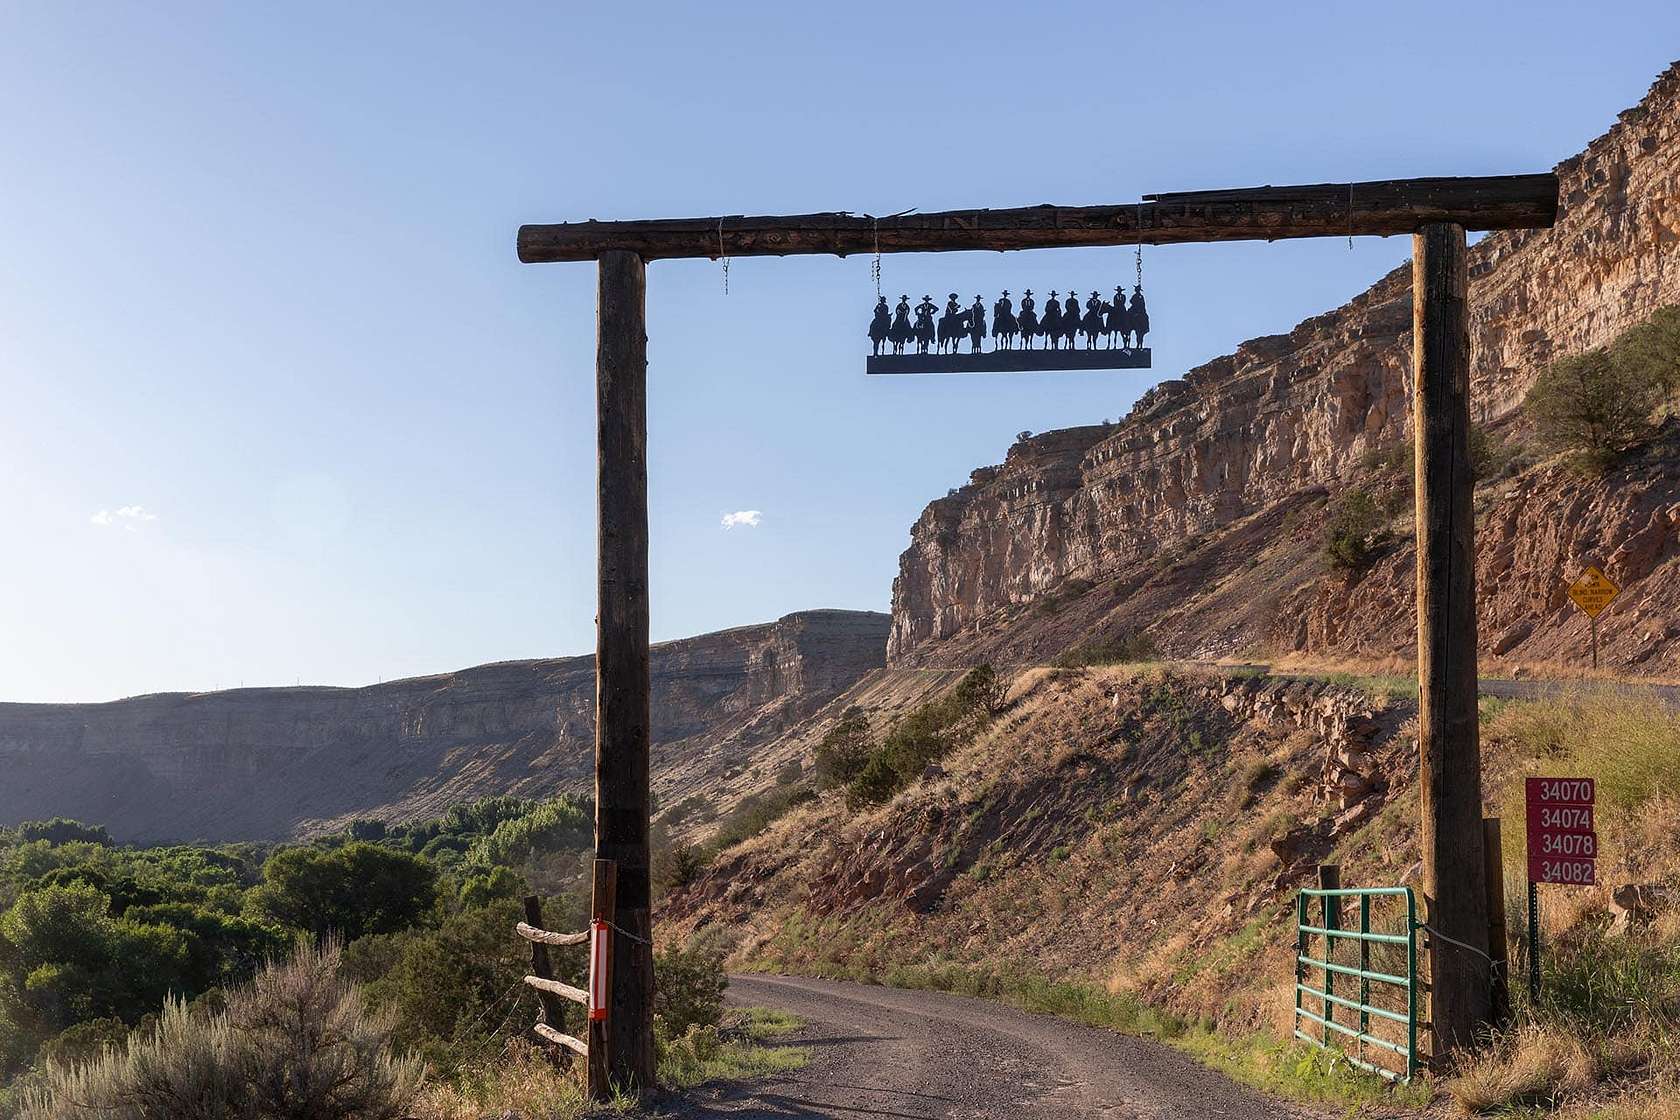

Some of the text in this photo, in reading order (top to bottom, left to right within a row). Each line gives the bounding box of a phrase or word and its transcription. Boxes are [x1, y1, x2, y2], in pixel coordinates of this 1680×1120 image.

[1540, 781, 1591, 801] 34070
[1541, 808, 1590, 829] 34074
[1542, 834, 1593, 855] 34078
[1541, 860, 1592, 882] 34082
